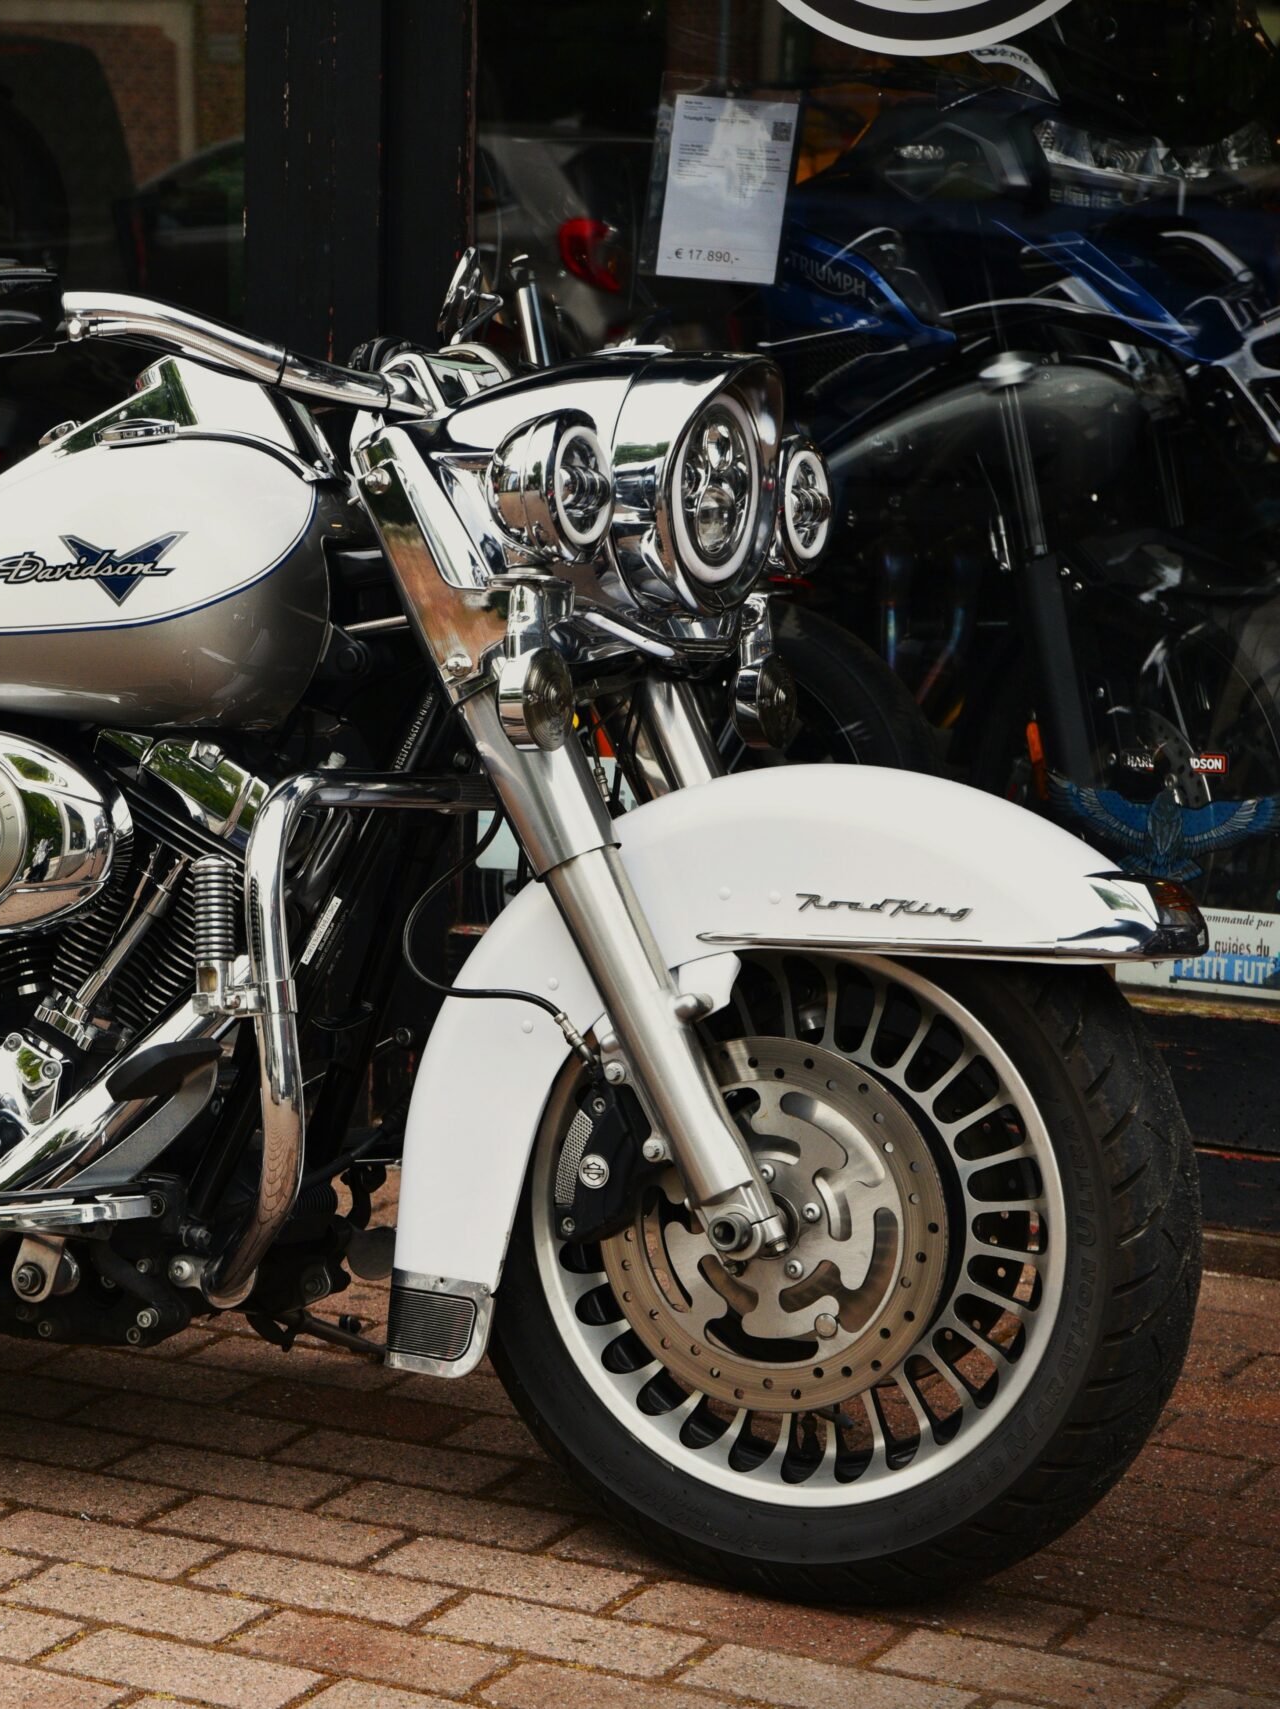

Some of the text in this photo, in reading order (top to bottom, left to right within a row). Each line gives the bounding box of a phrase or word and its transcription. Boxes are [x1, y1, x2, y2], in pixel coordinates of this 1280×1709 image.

[675, 248, 739, 264] € 17.890,-
[789, 251, 867, 299] TRIUMPH
[1204, 913, 1275, 930] commandé par
[1256, 938, 1270, 957] du
[1181, 957, 1228, 980] PETIT
[1064, 1116, 1098, 1248] ULTRA
